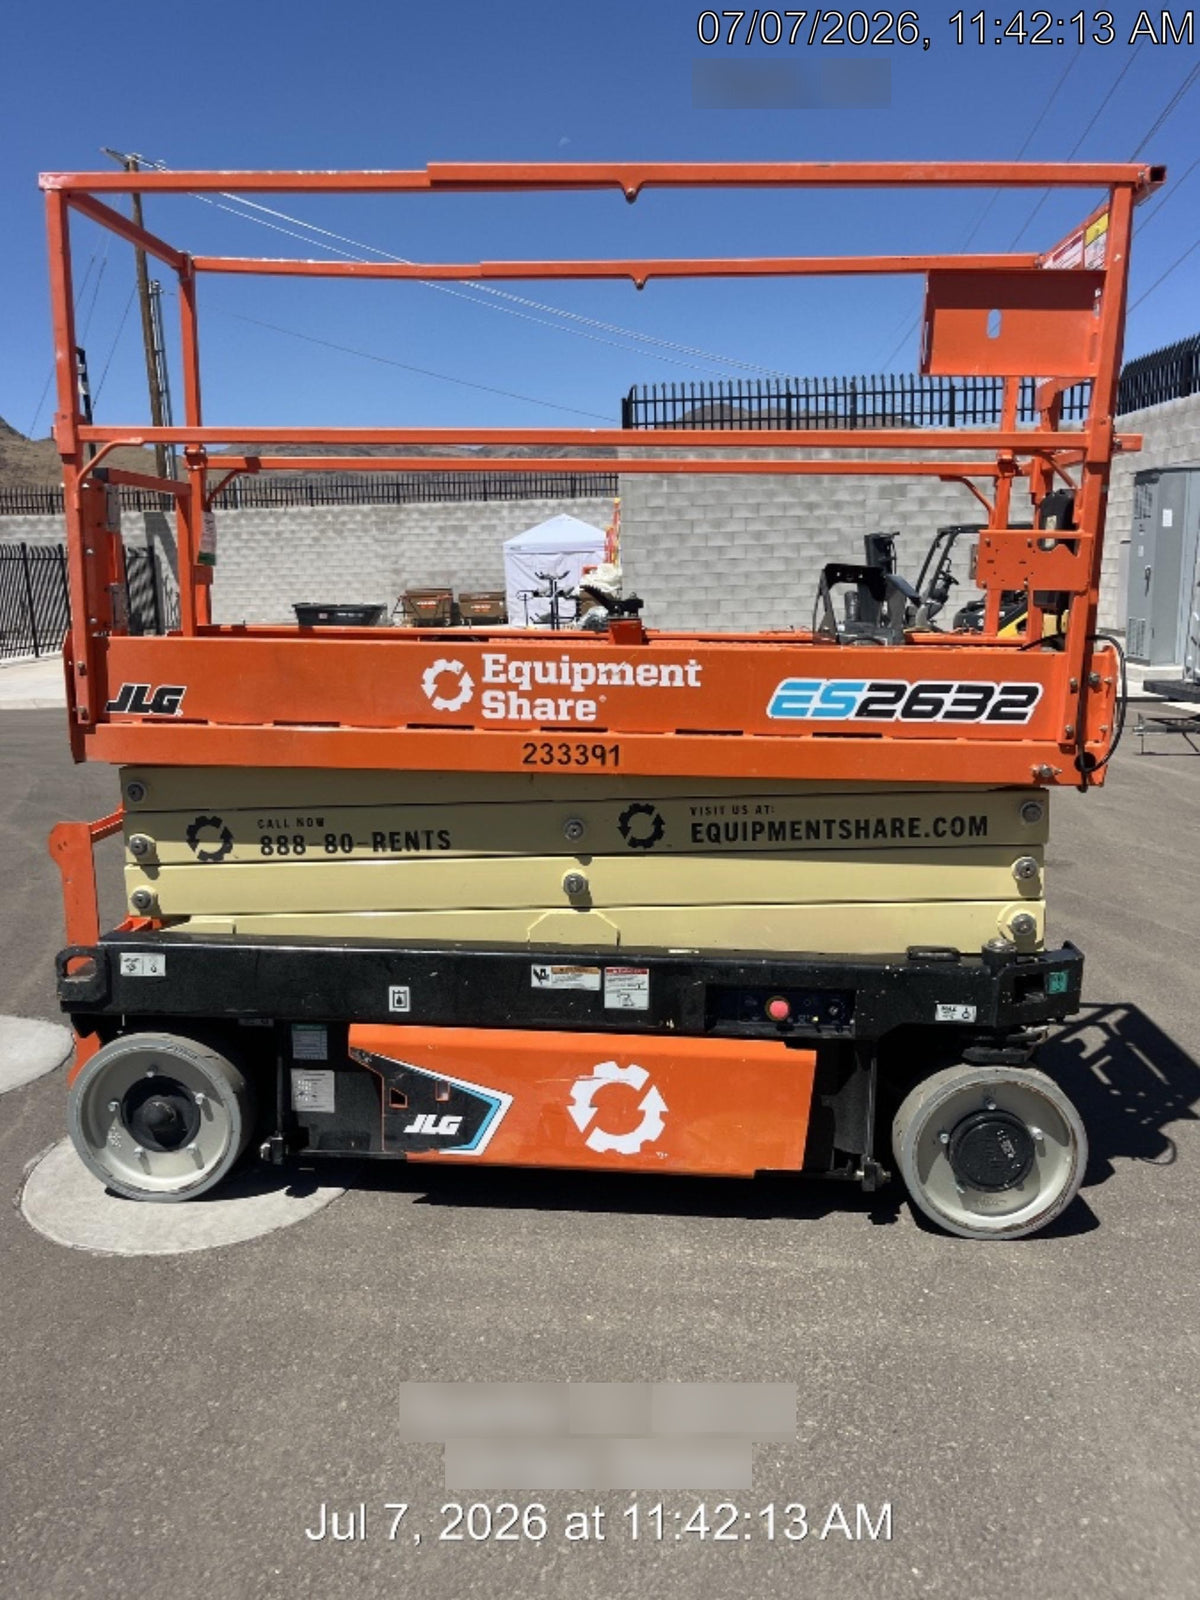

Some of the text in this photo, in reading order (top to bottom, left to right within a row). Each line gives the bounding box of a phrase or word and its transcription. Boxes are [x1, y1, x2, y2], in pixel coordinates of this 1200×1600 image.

[481, 653, 703, 692] Equipment
[105, 682, 187, 716] JLG
[481, 690, 598, 722] Share
[766, 678, 1044, 724] ES2632
[522, 742, 621, 766] 233391
[257, 817, 325, 829] CALL NOW
[690, 804, 775, 816] VISIT US AT:
[690, 815, 988, 844] EQUIPMENTSHARE.COM
[403, 1114, 464, 1136] JLG
